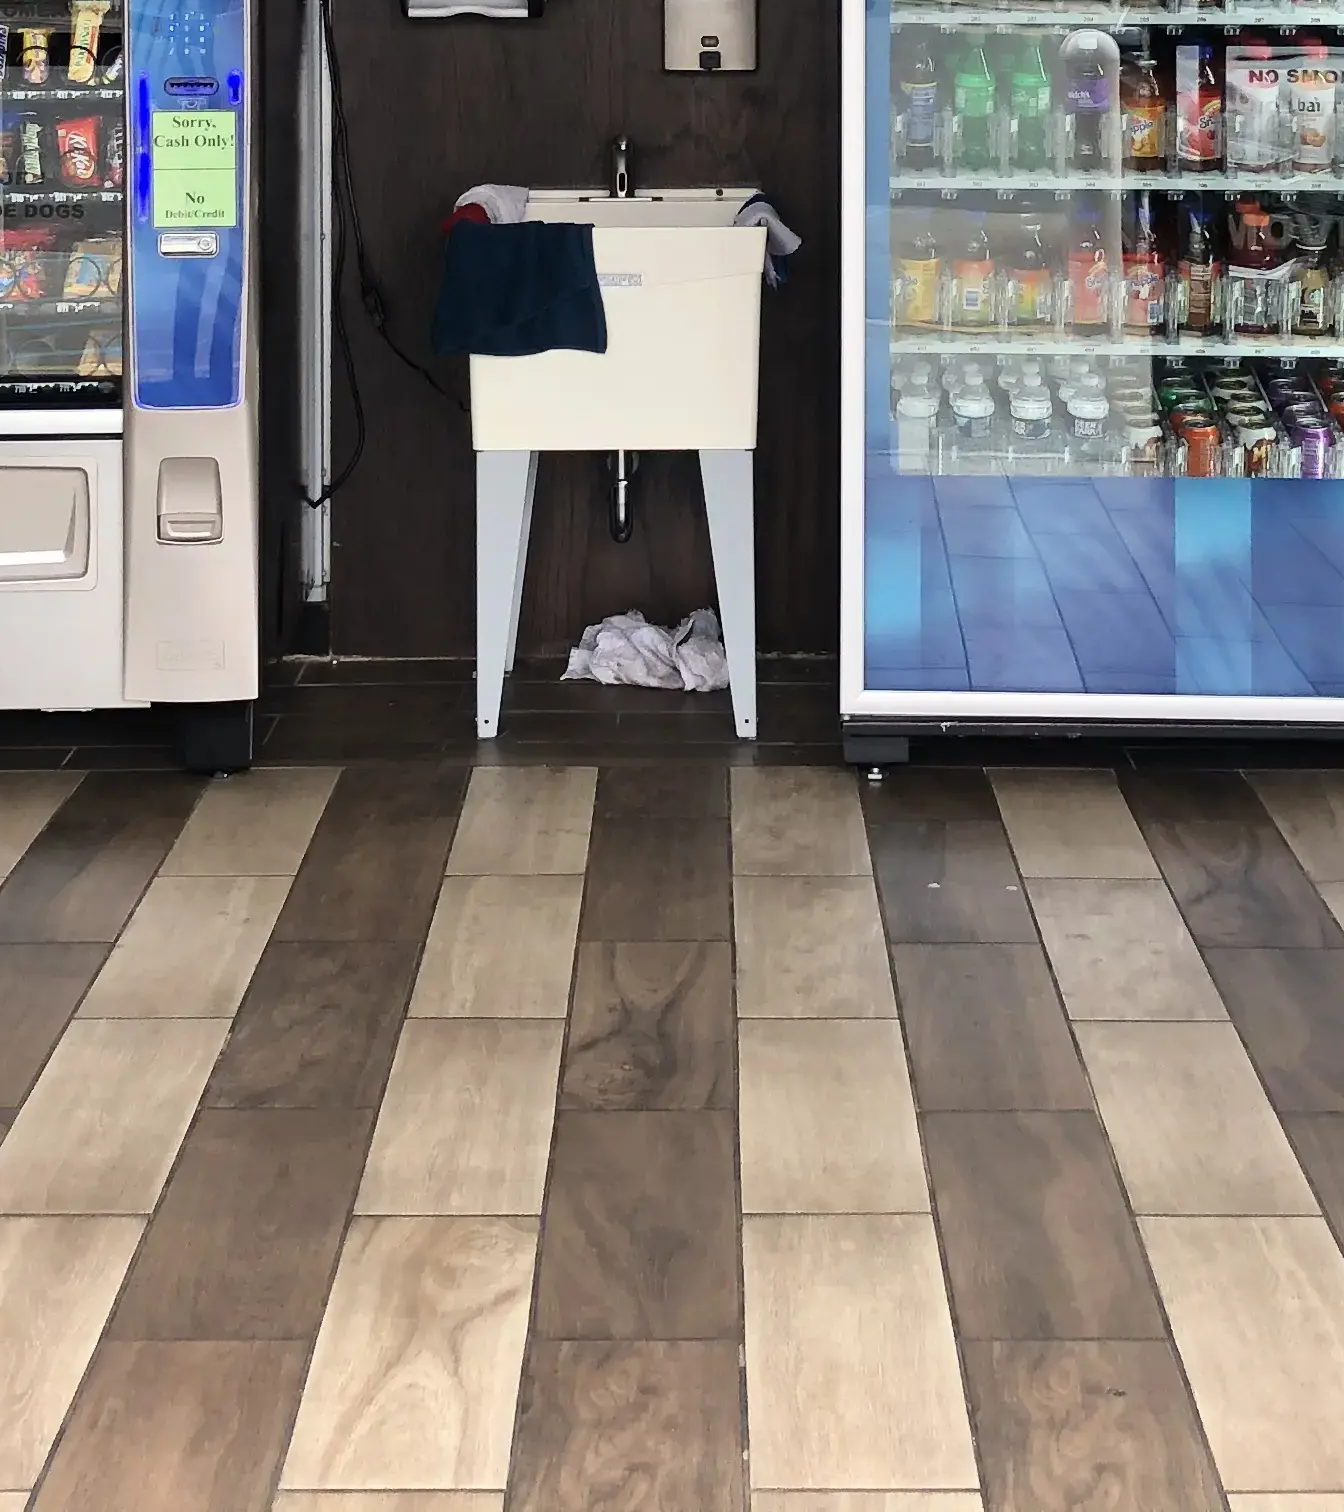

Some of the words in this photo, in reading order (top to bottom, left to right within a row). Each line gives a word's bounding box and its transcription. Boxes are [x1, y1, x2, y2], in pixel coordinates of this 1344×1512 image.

[1248, 68, 1280, 85] NO
[154, 134, 189, 148] Cash
[194, 134, 235, 150] Only!
[186, 191, 205, 205] No
[24, 203, 85, 219] DOGS
[165, 209, 225, 219] Debit/Credit
